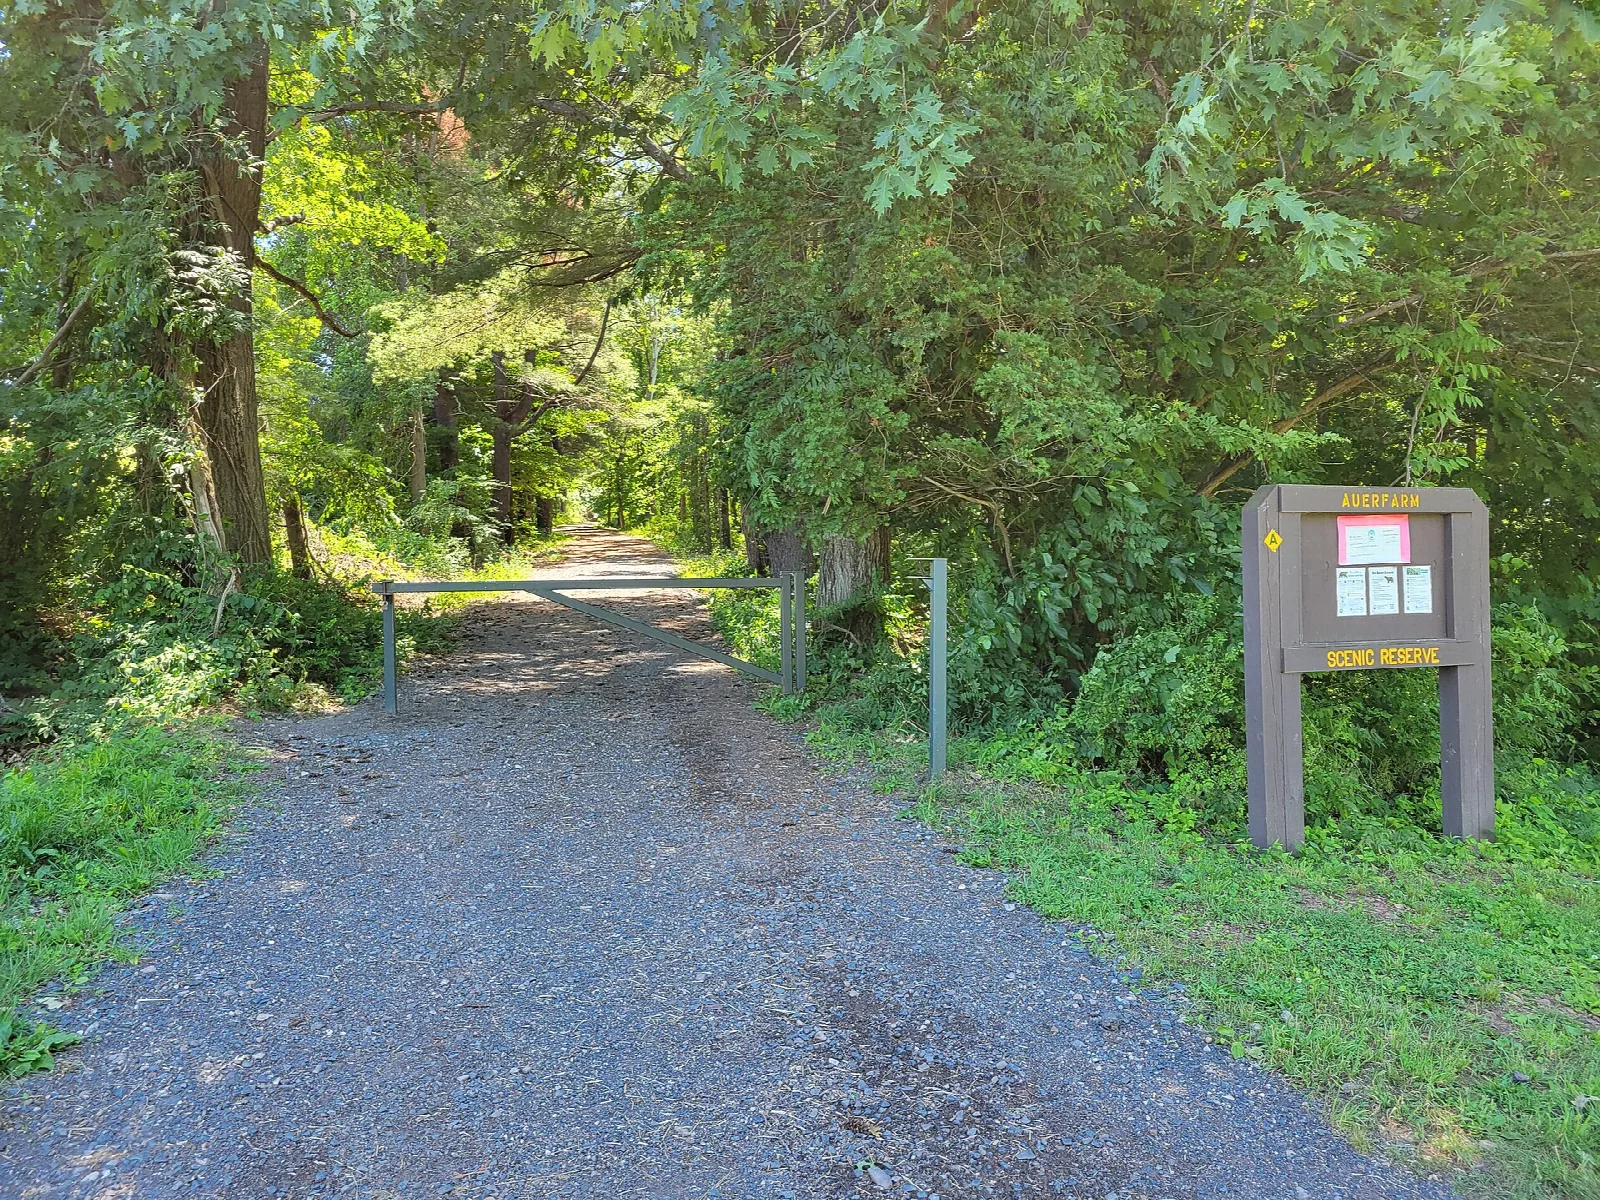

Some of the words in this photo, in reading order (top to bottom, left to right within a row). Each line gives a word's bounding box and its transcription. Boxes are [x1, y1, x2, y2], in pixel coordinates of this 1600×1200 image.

[1342, 492, 1419, 508] AUERFARM
[1269, 533, 1278, 545] A
[1327, 648, 1374, 668] SCENIC
[1380, 647, 1440, 665] RESERVE
